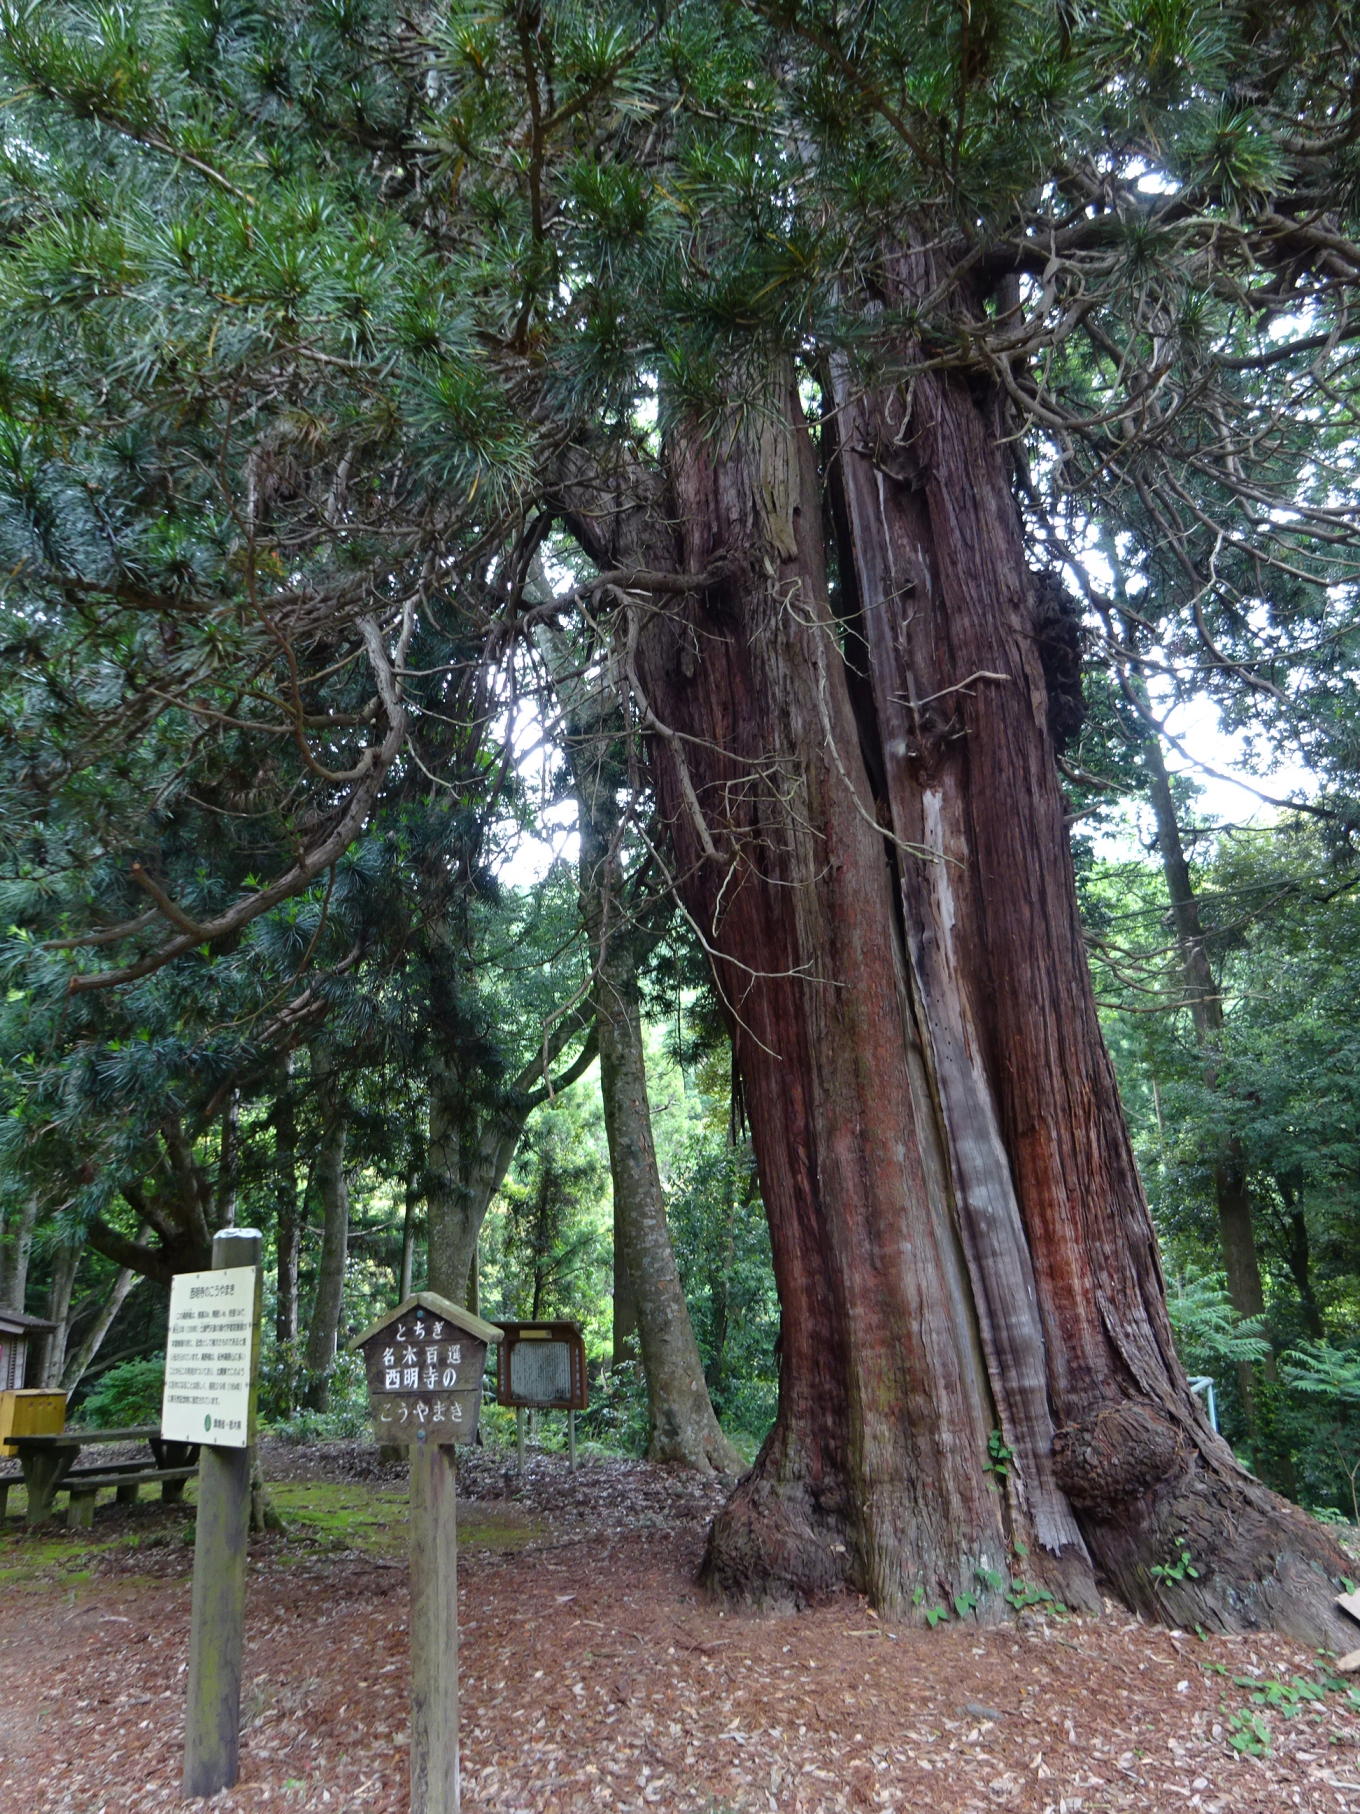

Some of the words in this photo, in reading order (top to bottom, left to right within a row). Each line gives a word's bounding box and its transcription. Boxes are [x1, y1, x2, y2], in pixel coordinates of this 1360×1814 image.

[396, 1320, 445, 1342] とちぎ
[382, 1344, 462, 1367] 名木百選
[385, 1366, 457, 1390] 西明寺の
[380, 1400, 463, 1423] こうやまき
